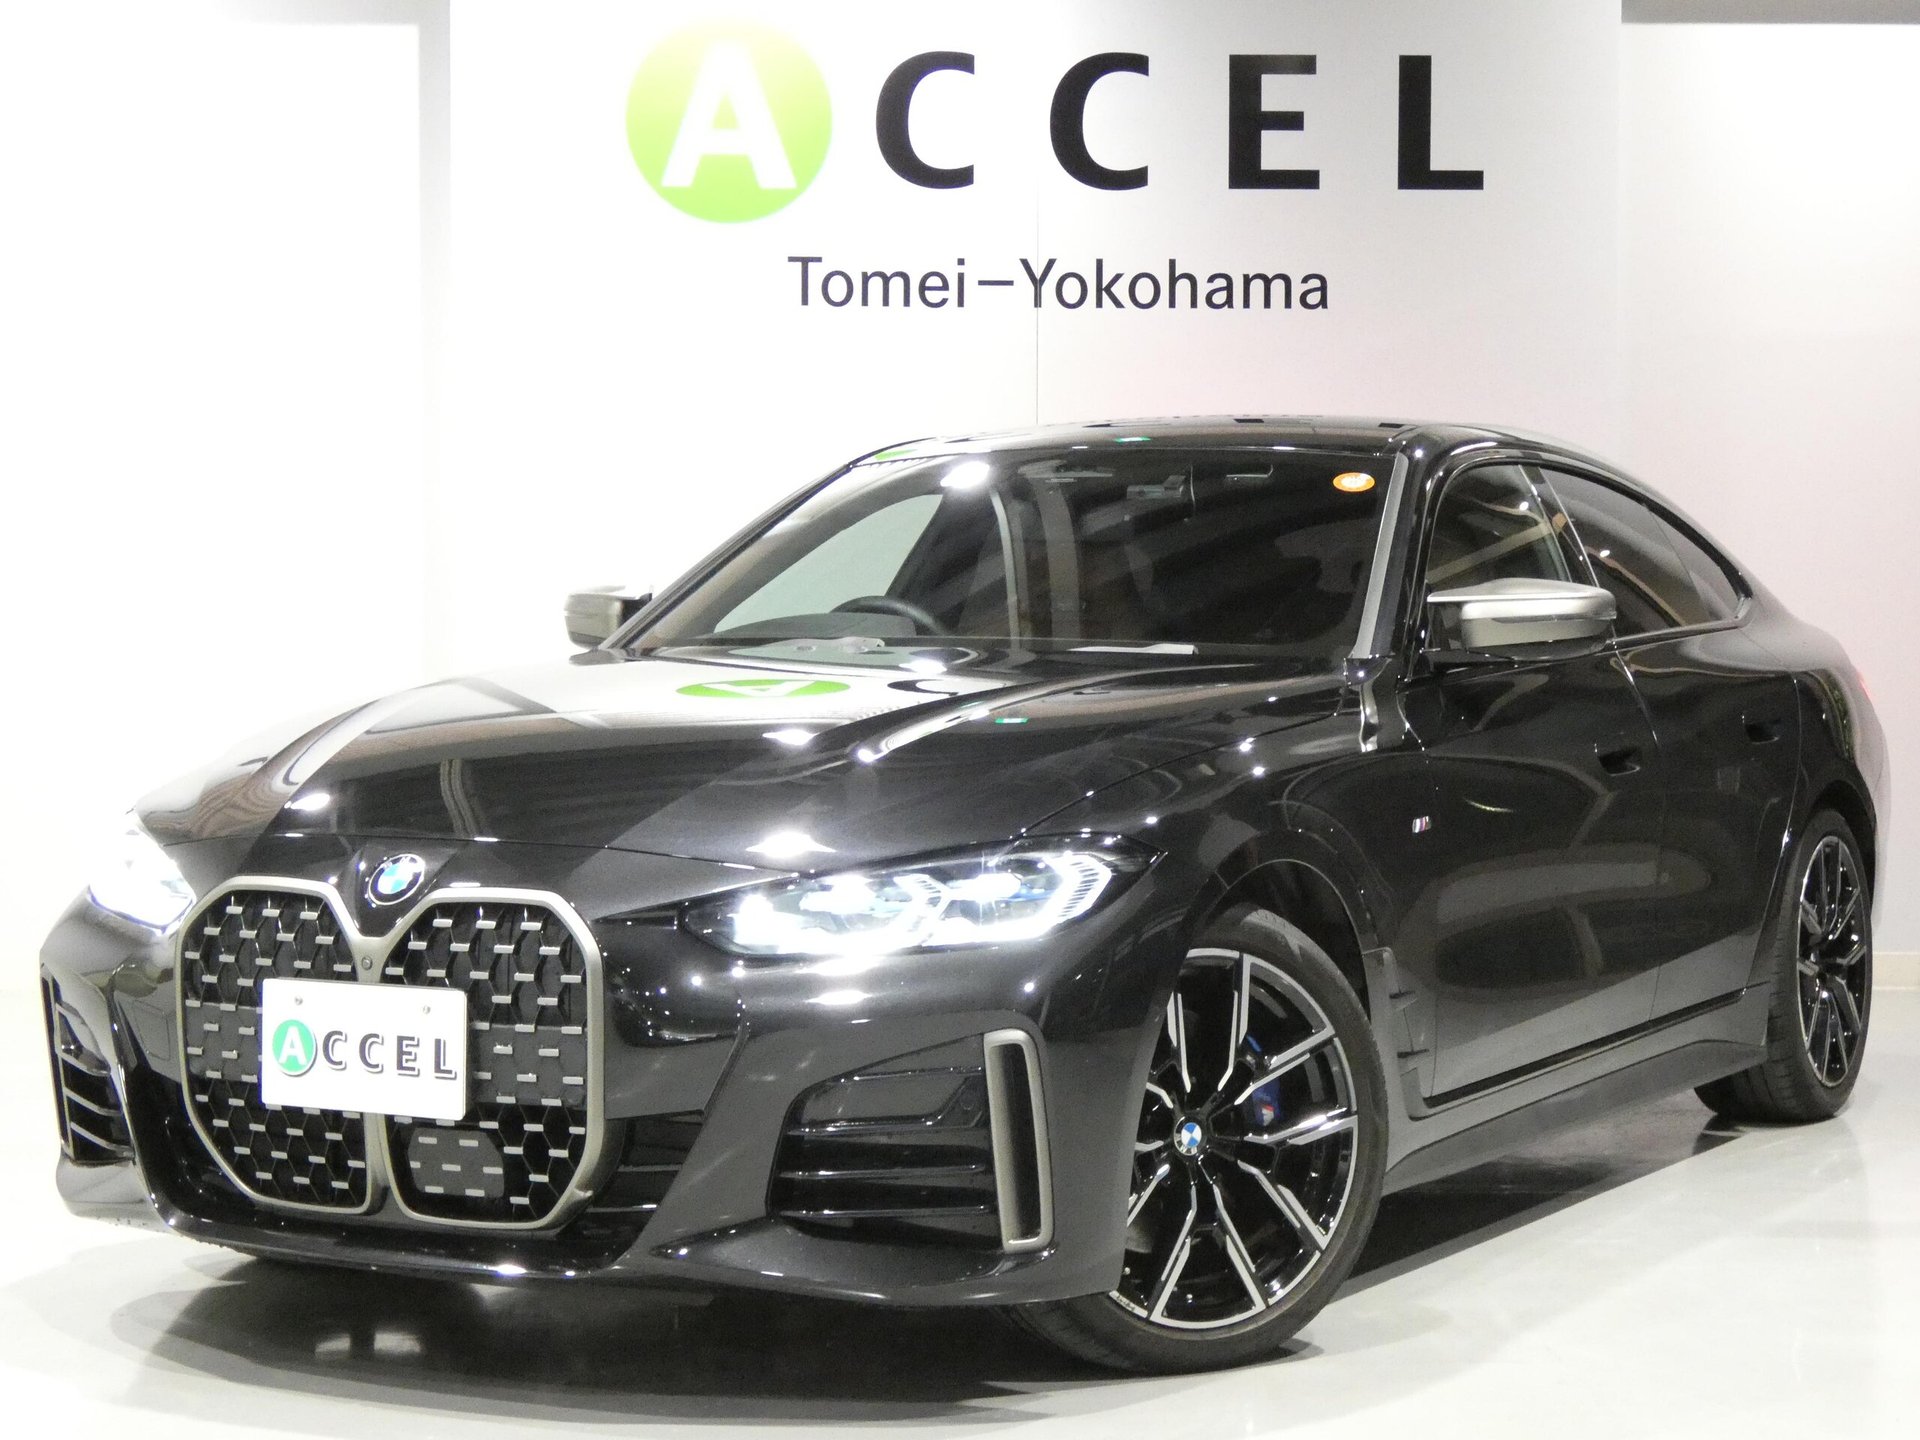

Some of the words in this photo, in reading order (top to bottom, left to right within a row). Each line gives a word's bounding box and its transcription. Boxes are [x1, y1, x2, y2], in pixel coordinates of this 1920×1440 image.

[660, 36, 1485, 191] ACCEL
[788, 256, 1329, 310] Tomei-Yokohama
[277, 1025, 457, 1080] ACCEL
